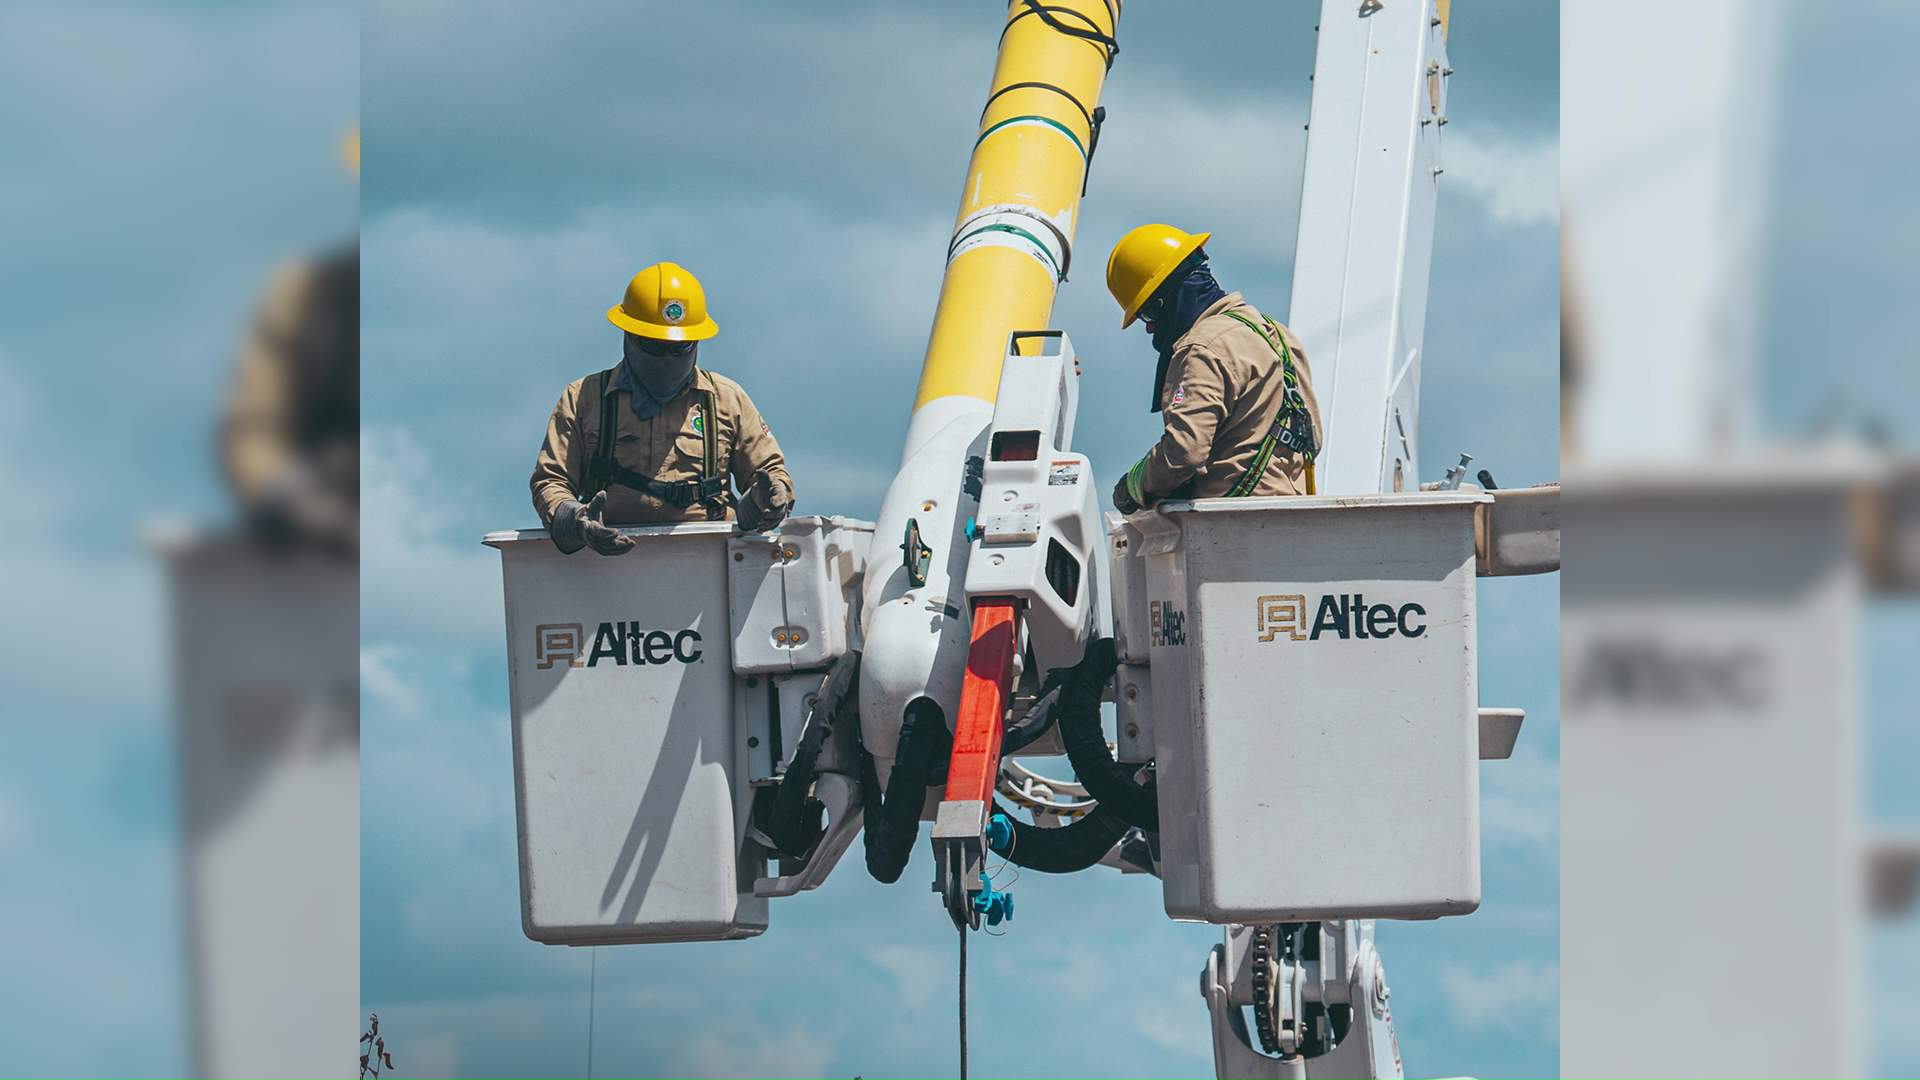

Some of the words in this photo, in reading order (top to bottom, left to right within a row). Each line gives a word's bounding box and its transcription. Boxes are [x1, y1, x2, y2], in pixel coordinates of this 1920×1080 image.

[1163, 600, 1185, 646] Altec
[1309, 594, 1427, 640] Altec
[587, 621, 703, 667] Altec
